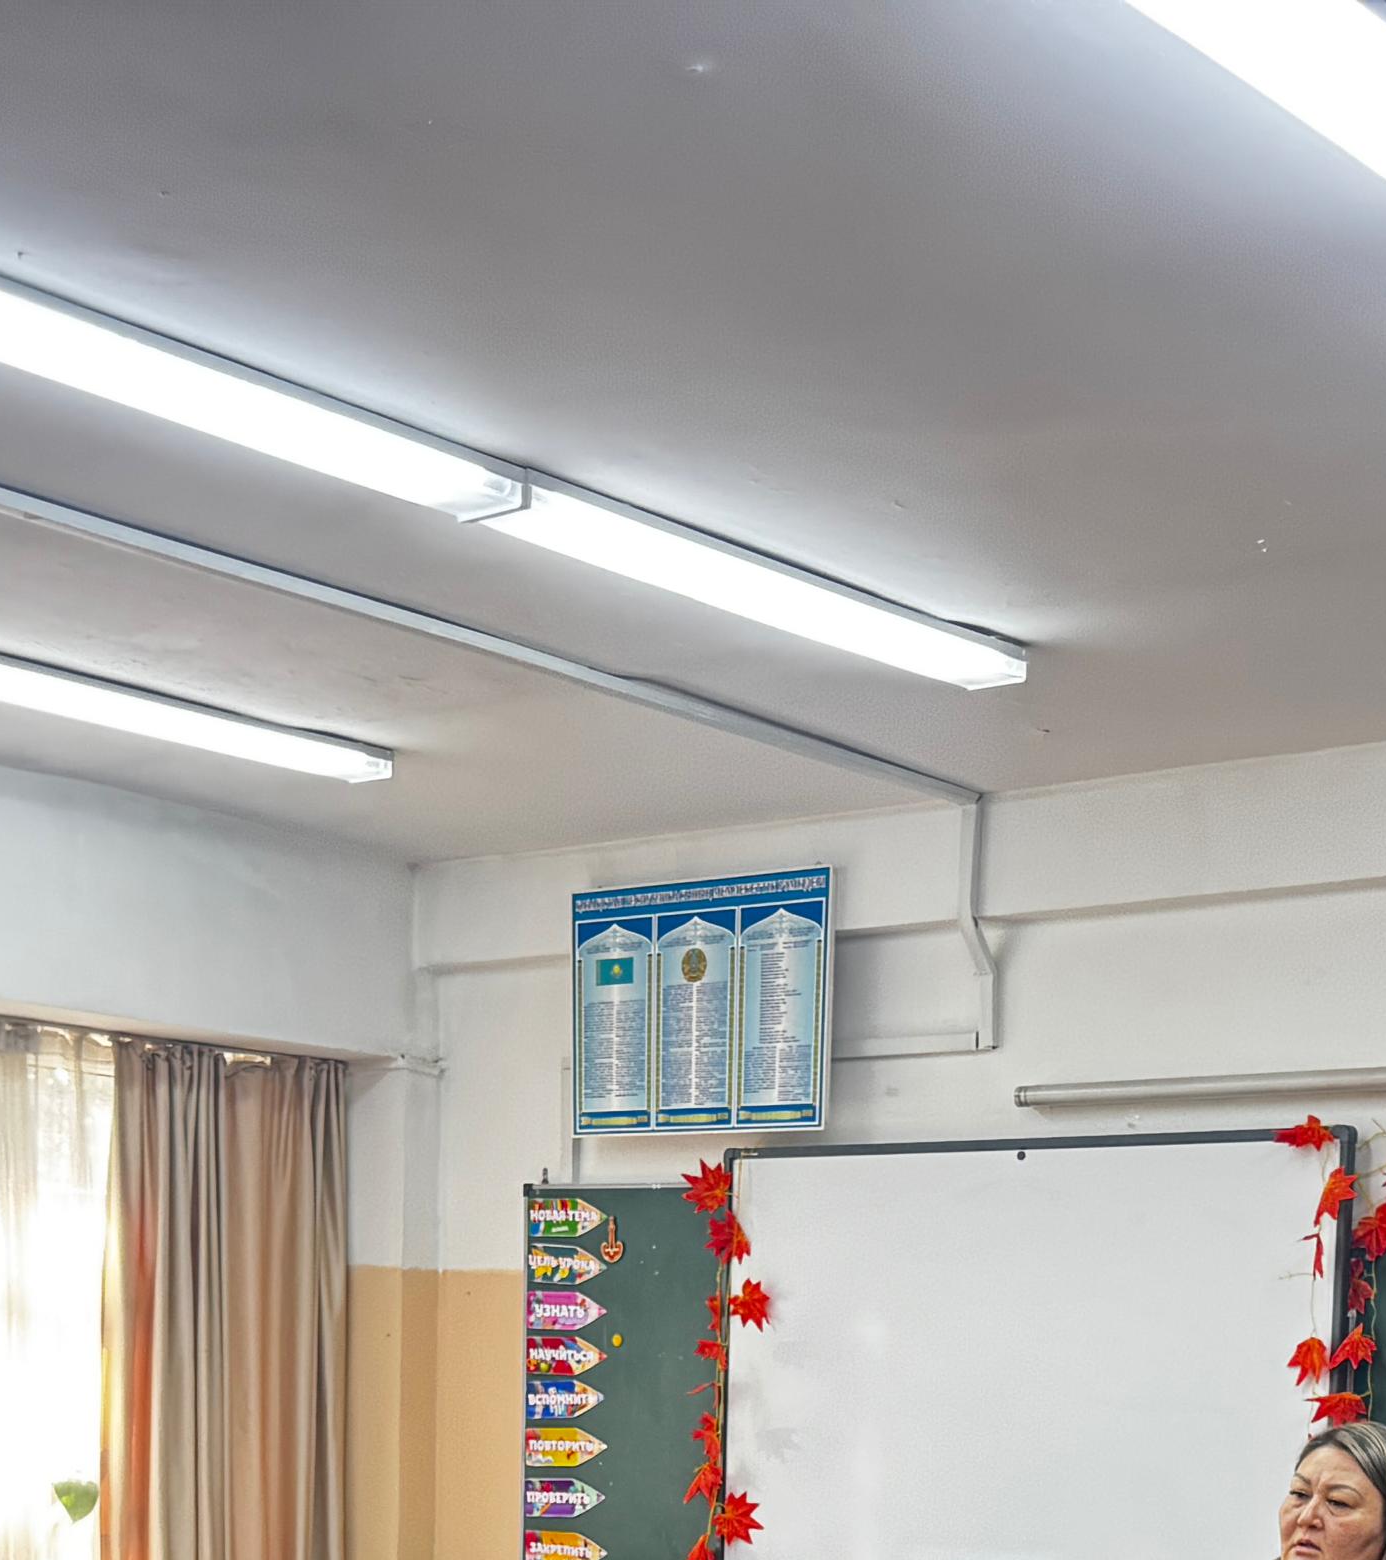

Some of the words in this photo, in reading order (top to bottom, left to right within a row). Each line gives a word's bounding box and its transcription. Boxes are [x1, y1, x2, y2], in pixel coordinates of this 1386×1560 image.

[530, 1209, 566, 1223] НОВАЯ
[568, 1210, 598, 1222] ТЕМА
[528, 1254, 557, 1269] ЦЕЛЬ
[533, 1303, 585, 1318] УЗНАТЬ
[529, 1348, 594, 1361] НАУЧИТЬСЯ
[528, 1440, 594, 1452] ПОВТОРИТЬ
[526, 1491, 591, 1504] ПРОВЕРИТЬ
[529, 1542, 592, 1558] ЗАКРЕПИТЬ
